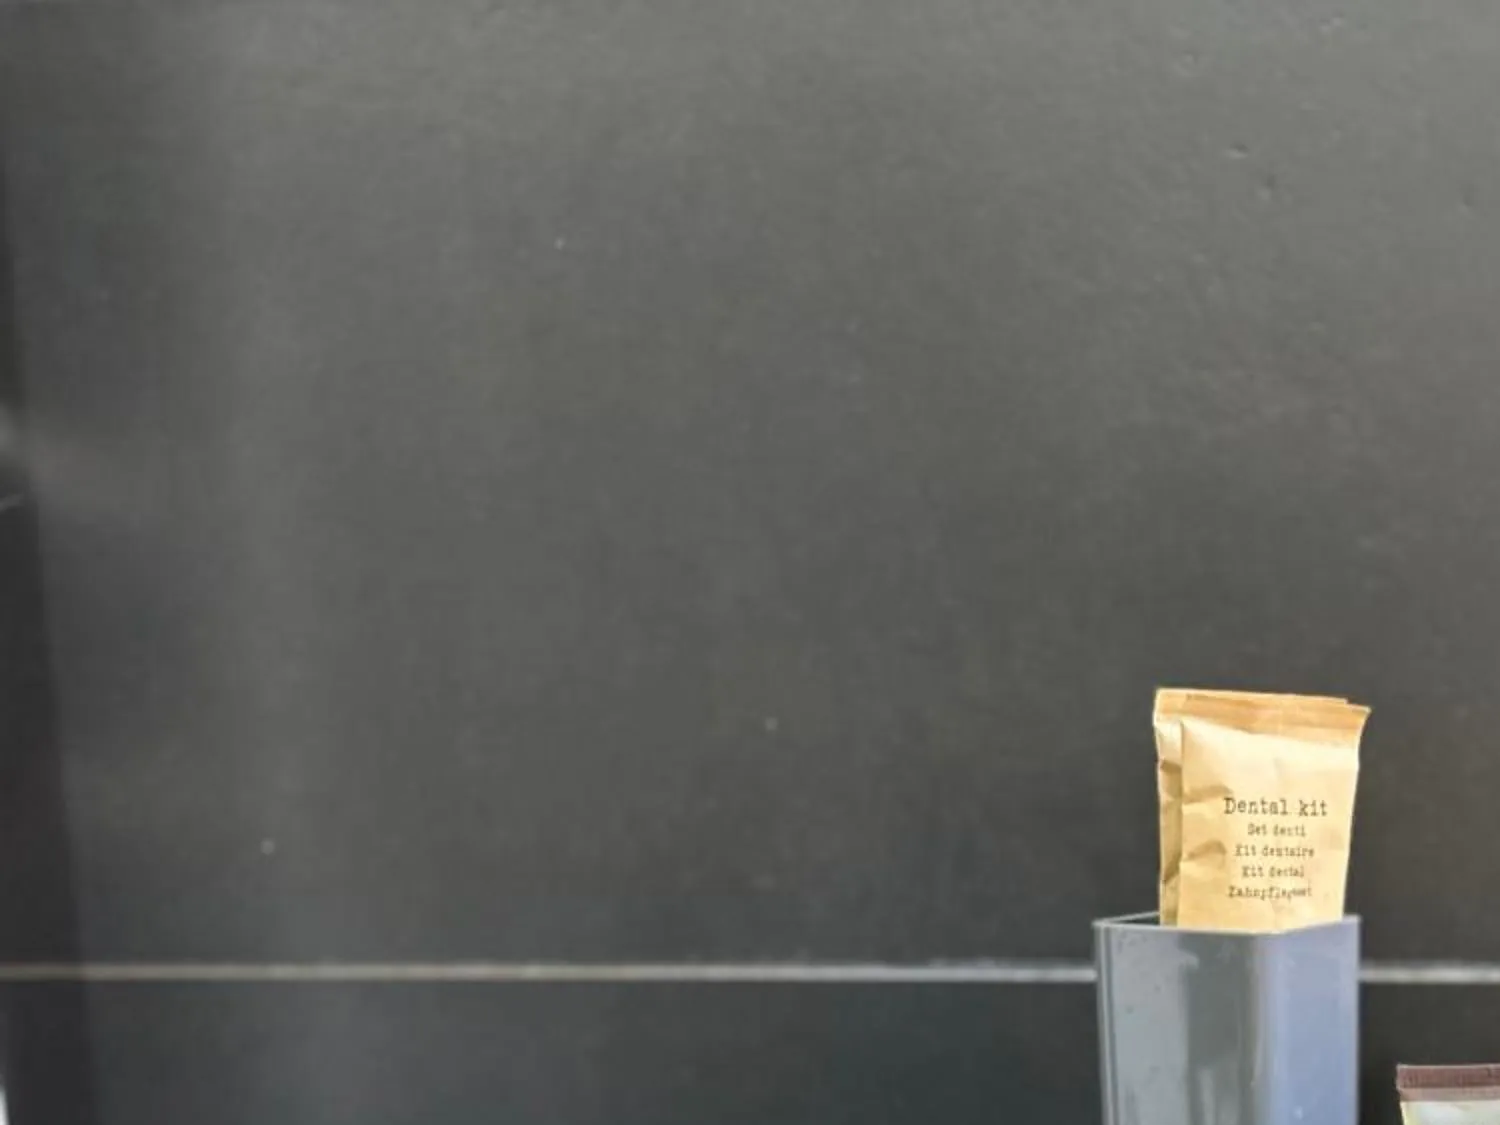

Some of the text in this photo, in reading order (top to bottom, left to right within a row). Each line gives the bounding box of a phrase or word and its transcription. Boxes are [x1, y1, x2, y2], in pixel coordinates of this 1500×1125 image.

[1223, 797, 1328, 817] Dental kit
[1235, 844, 1256, 857] Kit
[1241, 866, 1263, 878] Kit
